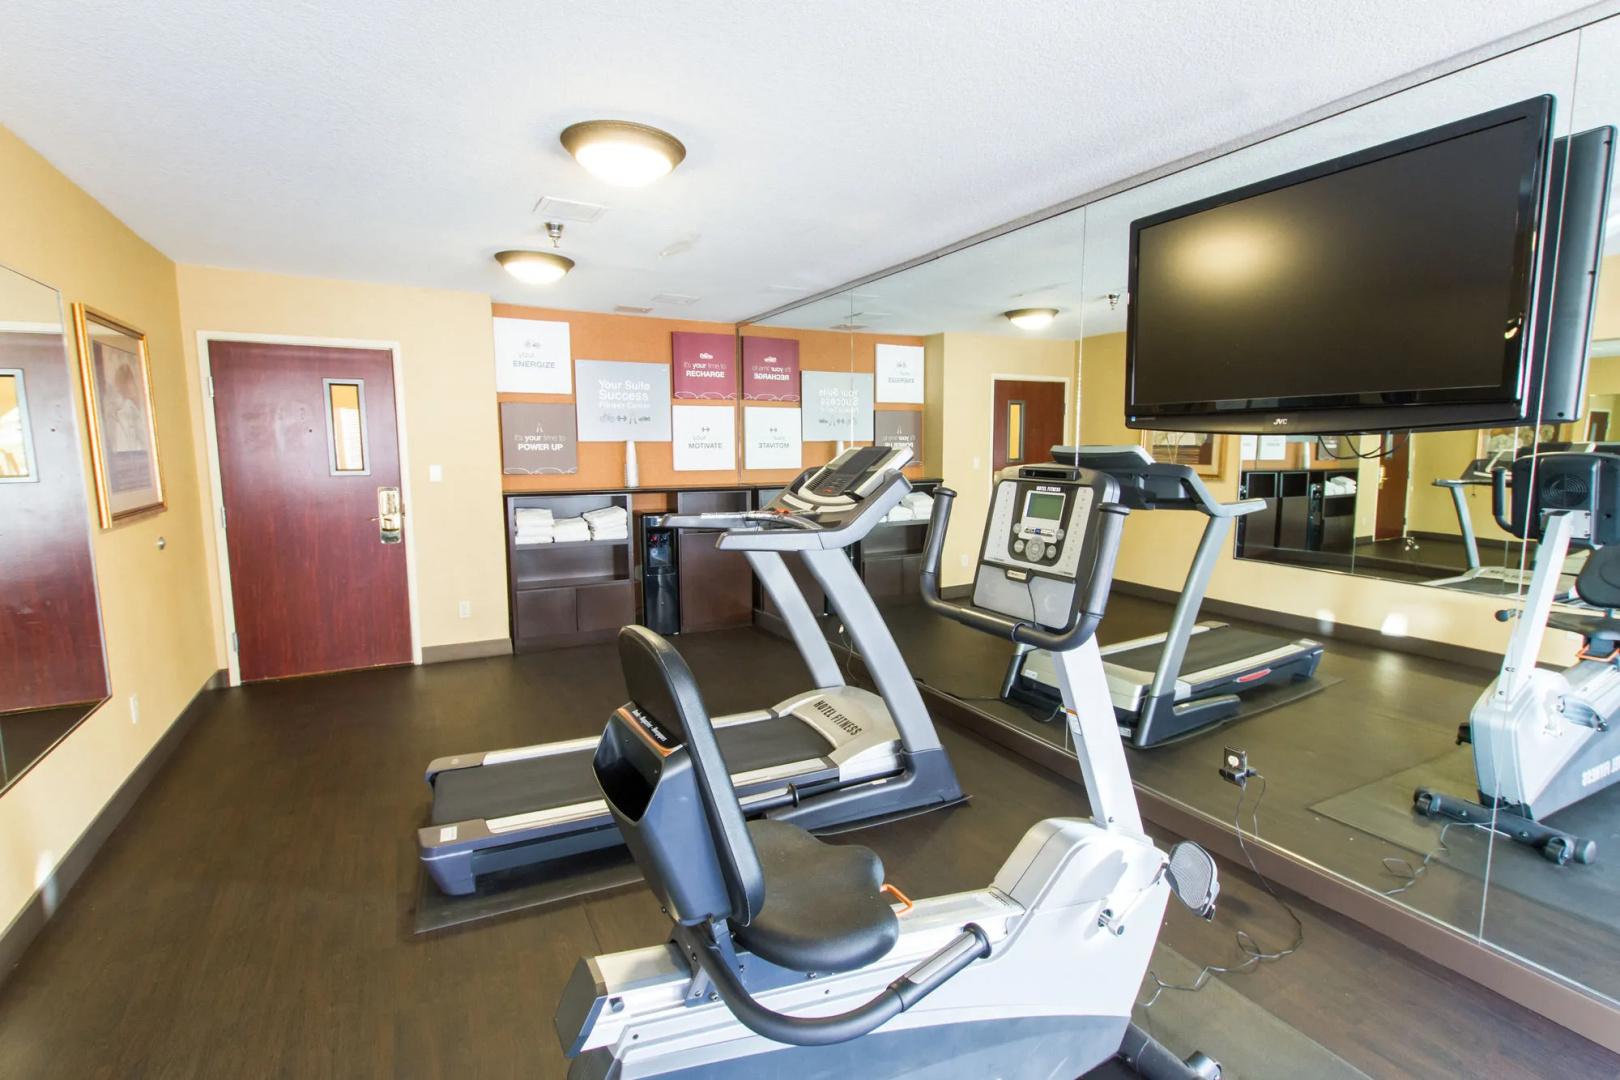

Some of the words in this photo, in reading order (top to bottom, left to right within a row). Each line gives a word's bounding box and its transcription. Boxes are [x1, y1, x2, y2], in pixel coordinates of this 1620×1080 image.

[512, 360, 556, 369] ENERGIZE
[692, 362, 706, 370] your
[685, 369, 726, 378] RECHARGE
[598, 379, 622, 390] Your
[624, 380, 651, 391] Suite
[599, 389, 649, 401] Success
[524, 435, 542, 443] your
[517, 443, 550, 451] POWER
[551, 443, 564, 451] UP
[813, 699, 837, 718] HOTEL
[830, 713, 863, 736] FITNESS
